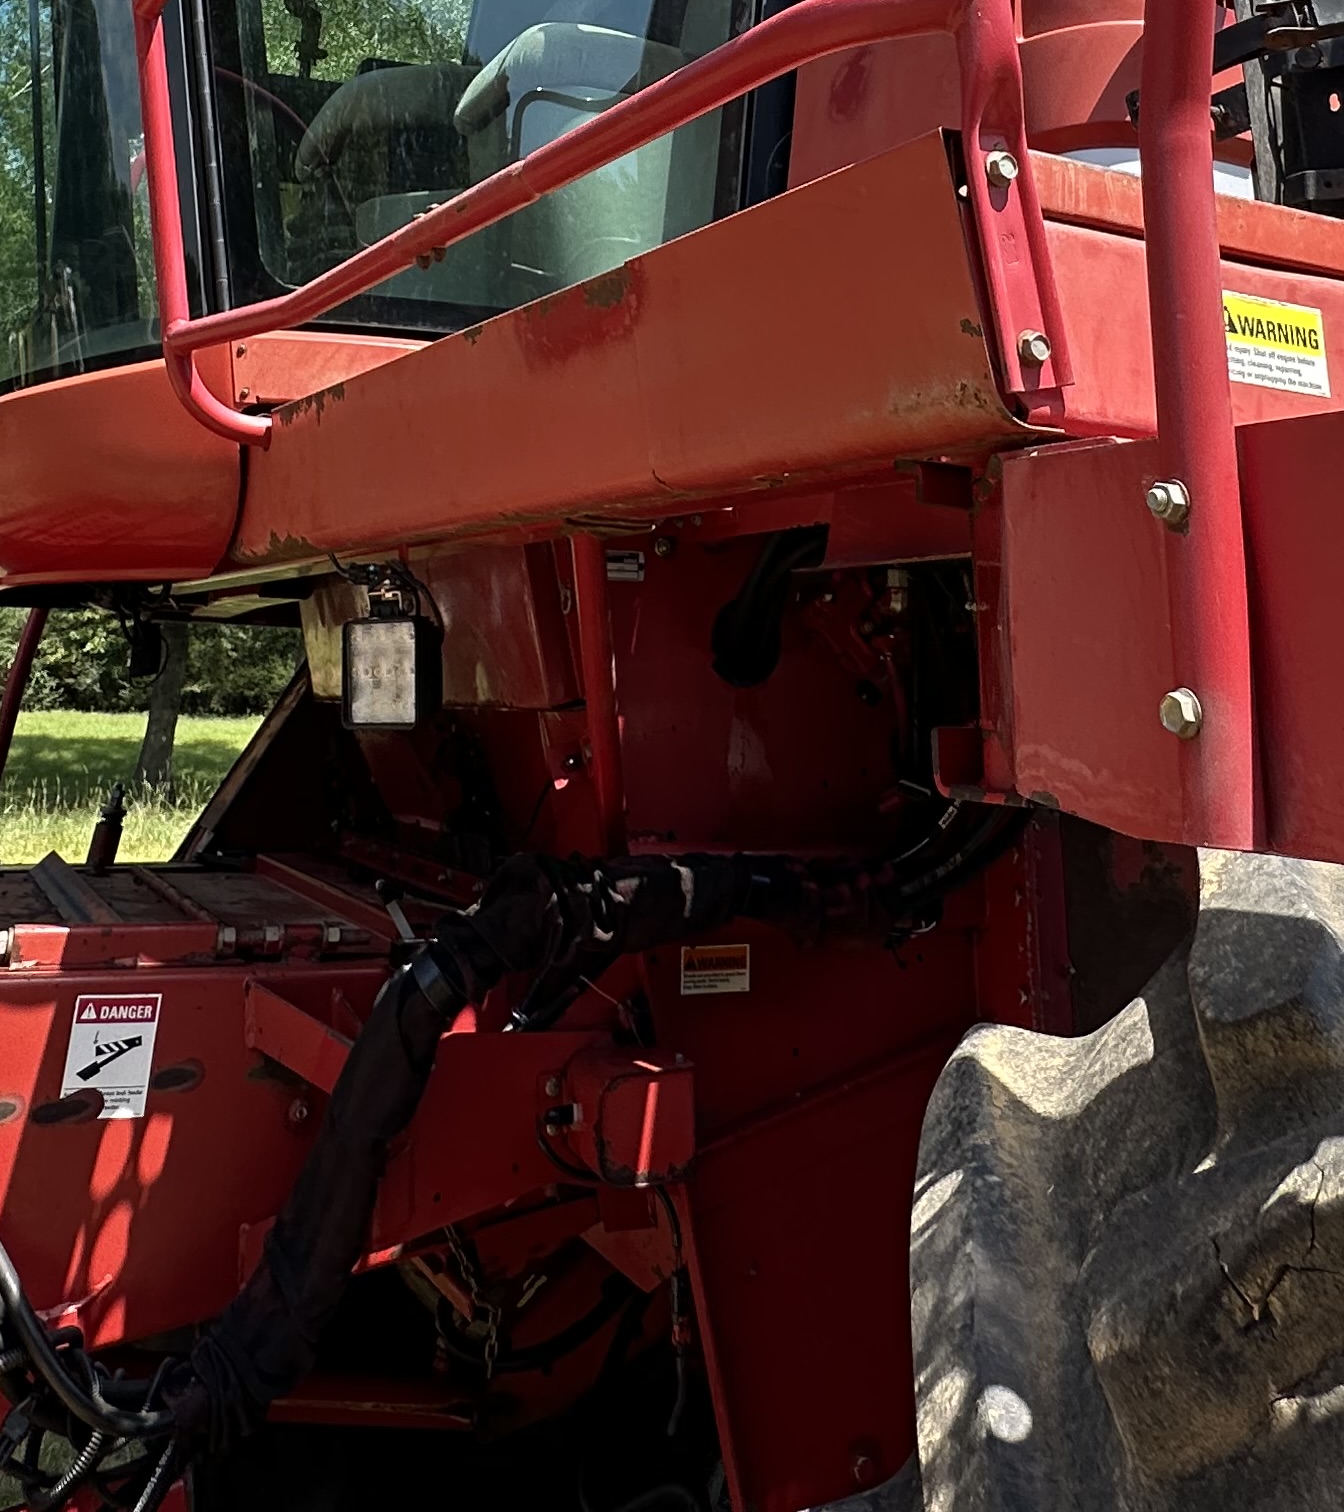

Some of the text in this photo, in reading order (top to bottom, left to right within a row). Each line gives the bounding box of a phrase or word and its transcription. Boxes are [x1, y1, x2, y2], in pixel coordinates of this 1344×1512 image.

[1237, 314, 1319, 350] WARNING
[697, 955, 747, 970] WARNING
[99, 1005, 153, 1019] DANGER
